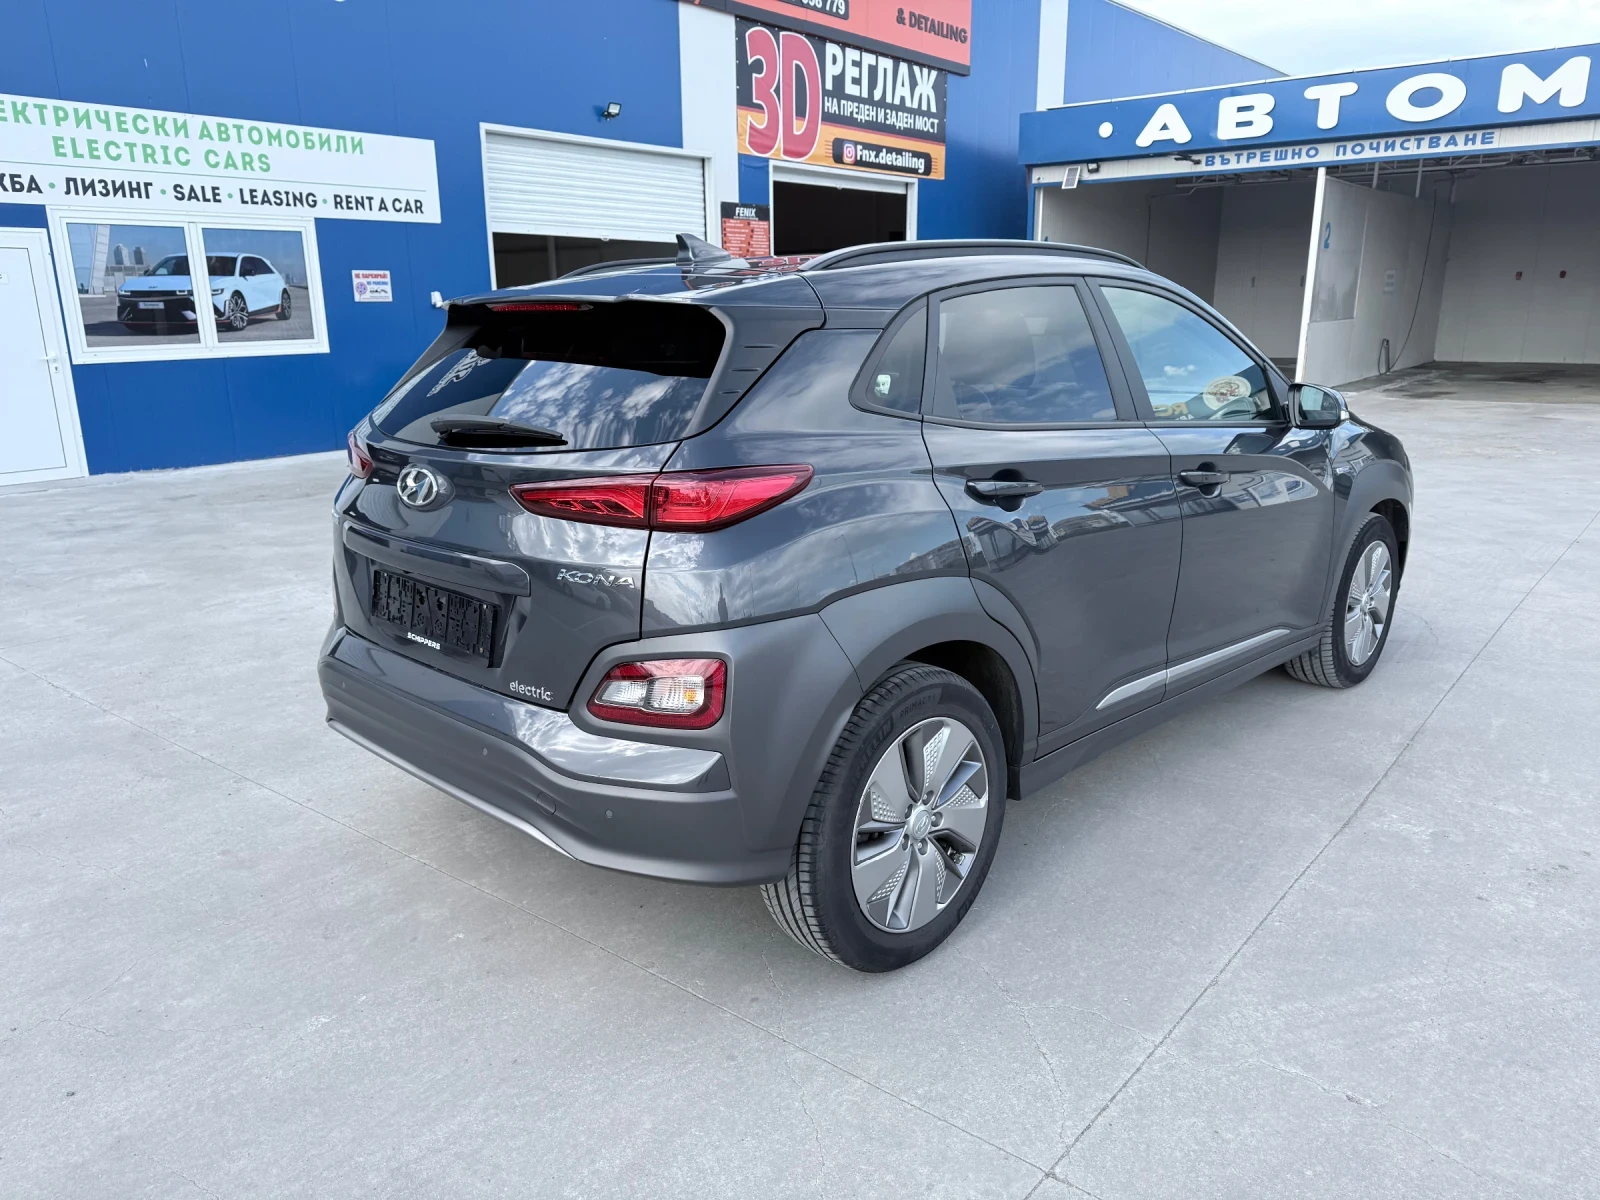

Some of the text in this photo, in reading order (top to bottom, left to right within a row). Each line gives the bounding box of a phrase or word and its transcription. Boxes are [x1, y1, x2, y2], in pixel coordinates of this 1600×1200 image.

[896, 8, 969, 44] & DETAILING
[825, 42, 938, 113] РЕГЛАЖ
[745, 26, 822, 161] 3D
[1135, 55, 1592, 148] АВТОМ
[824, 96, 939, 133] НА ПРЕДЕН И ЗАДЕН МОСТ
[199, 120, 365, 155] АВТОМОБИЛИ
[1205, 130, 1496, 168] ВЪТРЕШНО ПОЧИСТВАНЕ
[52, 136, 271, 173] ELECTRIC CARS
[856, 145, 925, 174] Fnx.detailing
[64, 176, 153, 200] ЛИЗИНГ
[173, 183, 222, 204] SALE
[239, 188, 318, 209] LEASING
[334, 194, 425, 215] RENT A CAR
[735, 207, 756, 217] FENIX
[1323, 221, 1331, 249] 2
[556, 569, 635, 588] KONA
[407, 632, 441, 650] SCHIPPERS
[509, 680, 552, 701] electric
